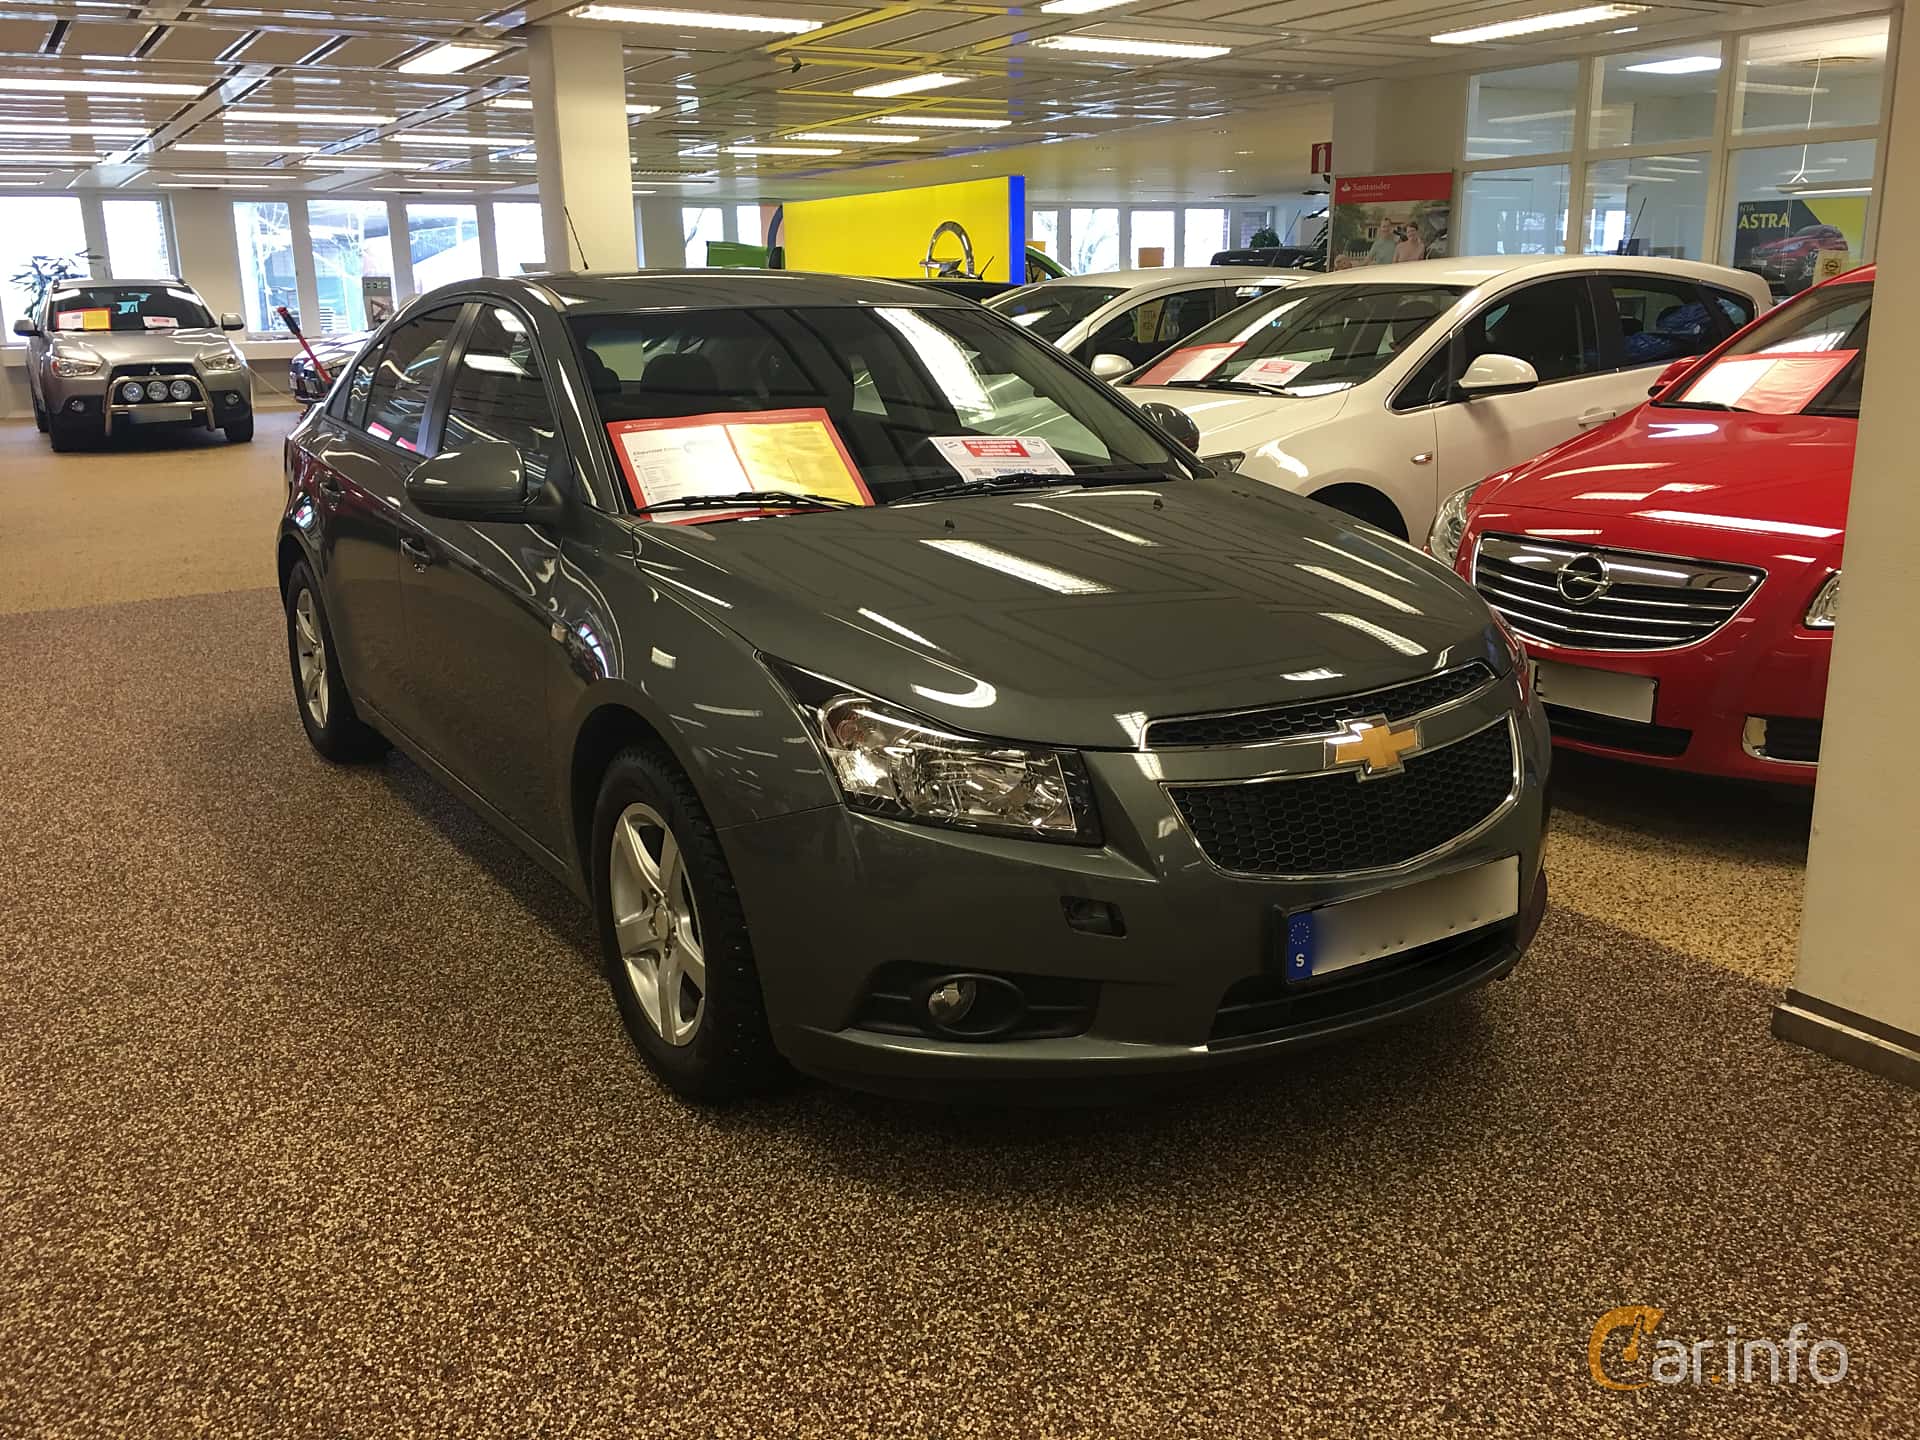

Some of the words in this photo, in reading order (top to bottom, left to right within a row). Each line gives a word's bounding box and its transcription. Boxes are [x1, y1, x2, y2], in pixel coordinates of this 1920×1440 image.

[1352, 181, 1392, 192] Santander
[1738, 213, 1790, 229] ASTRA
[1295, 953, 1305, 968] S
